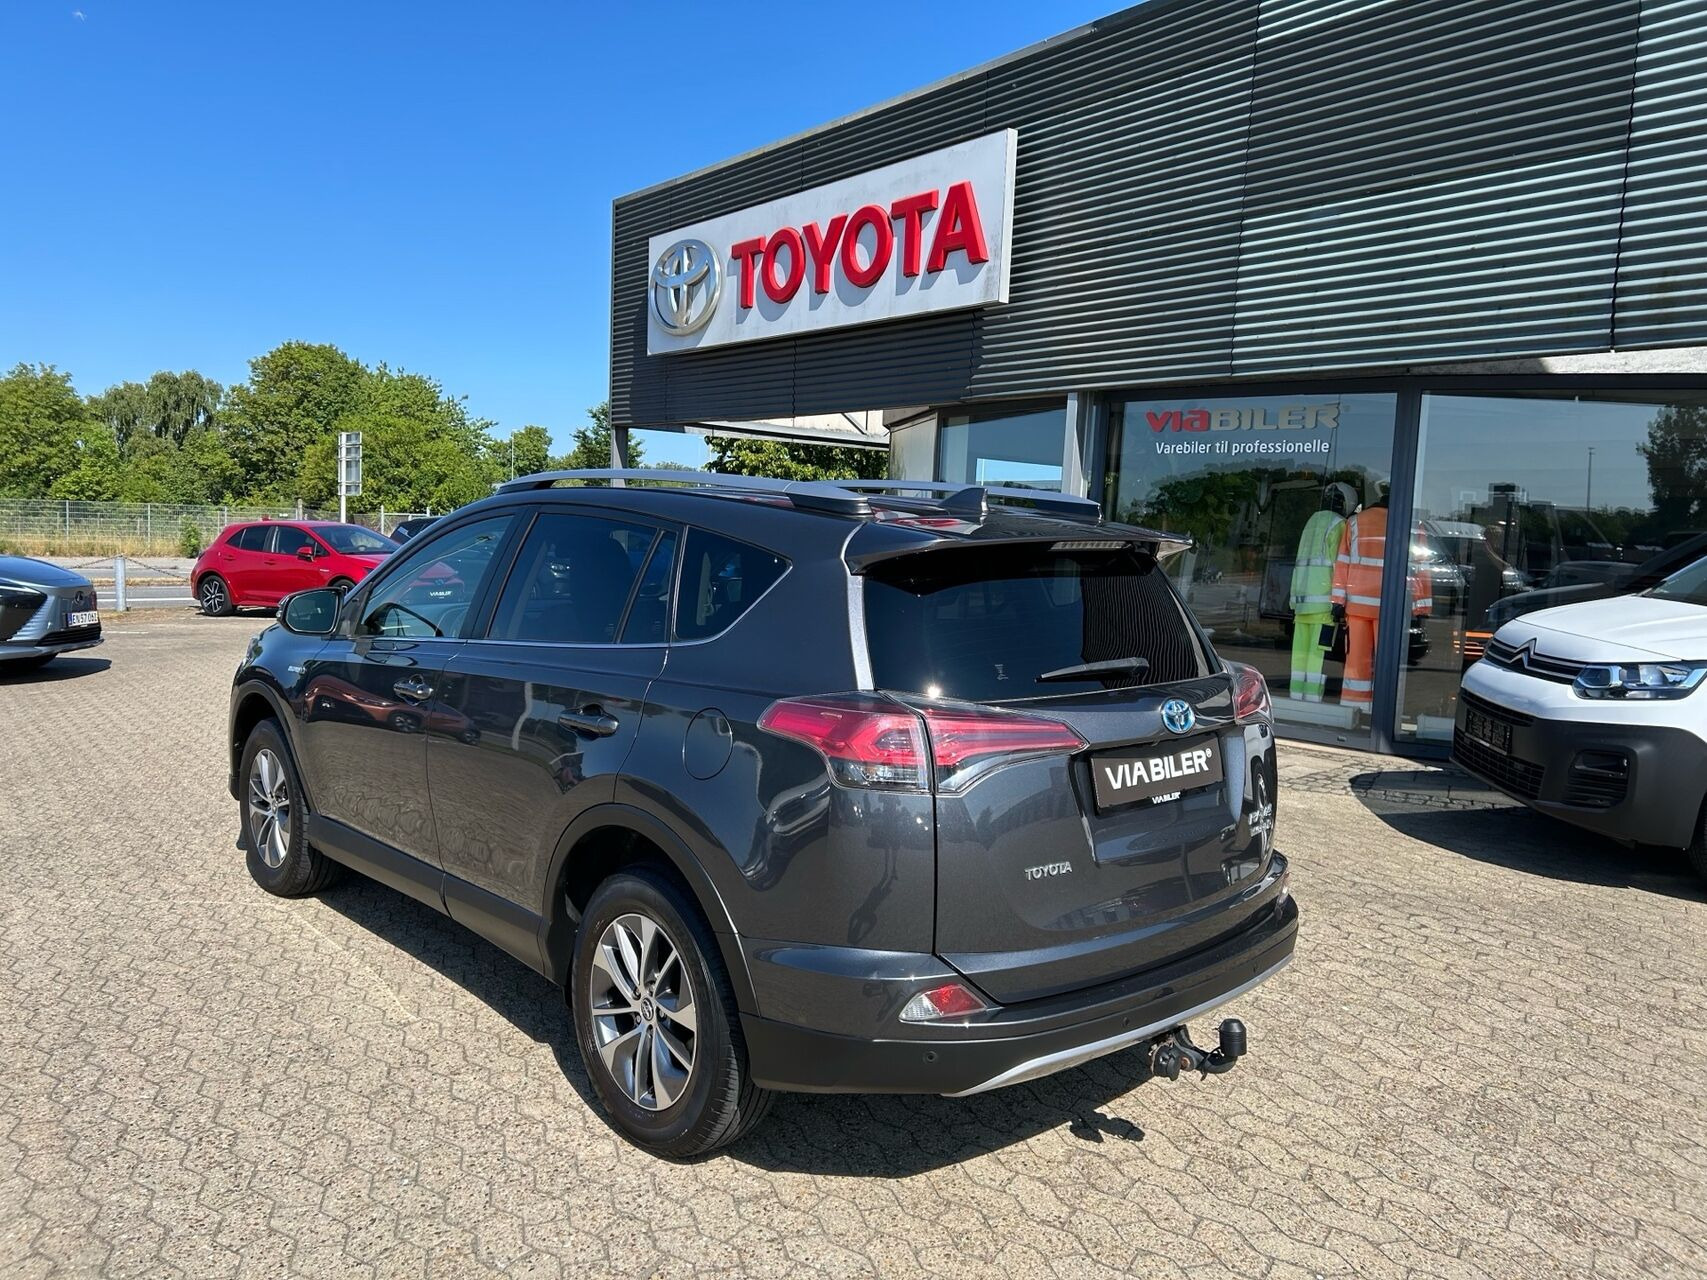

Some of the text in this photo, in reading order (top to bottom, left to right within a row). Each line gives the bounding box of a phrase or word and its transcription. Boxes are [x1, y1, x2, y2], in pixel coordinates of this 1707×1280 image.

[731, 180, 990, 309] TOYOTA
[1155, 439, 1331, 456] Varebiler til professionelle
[1024, 861, 1073, 881] TOYOTA
